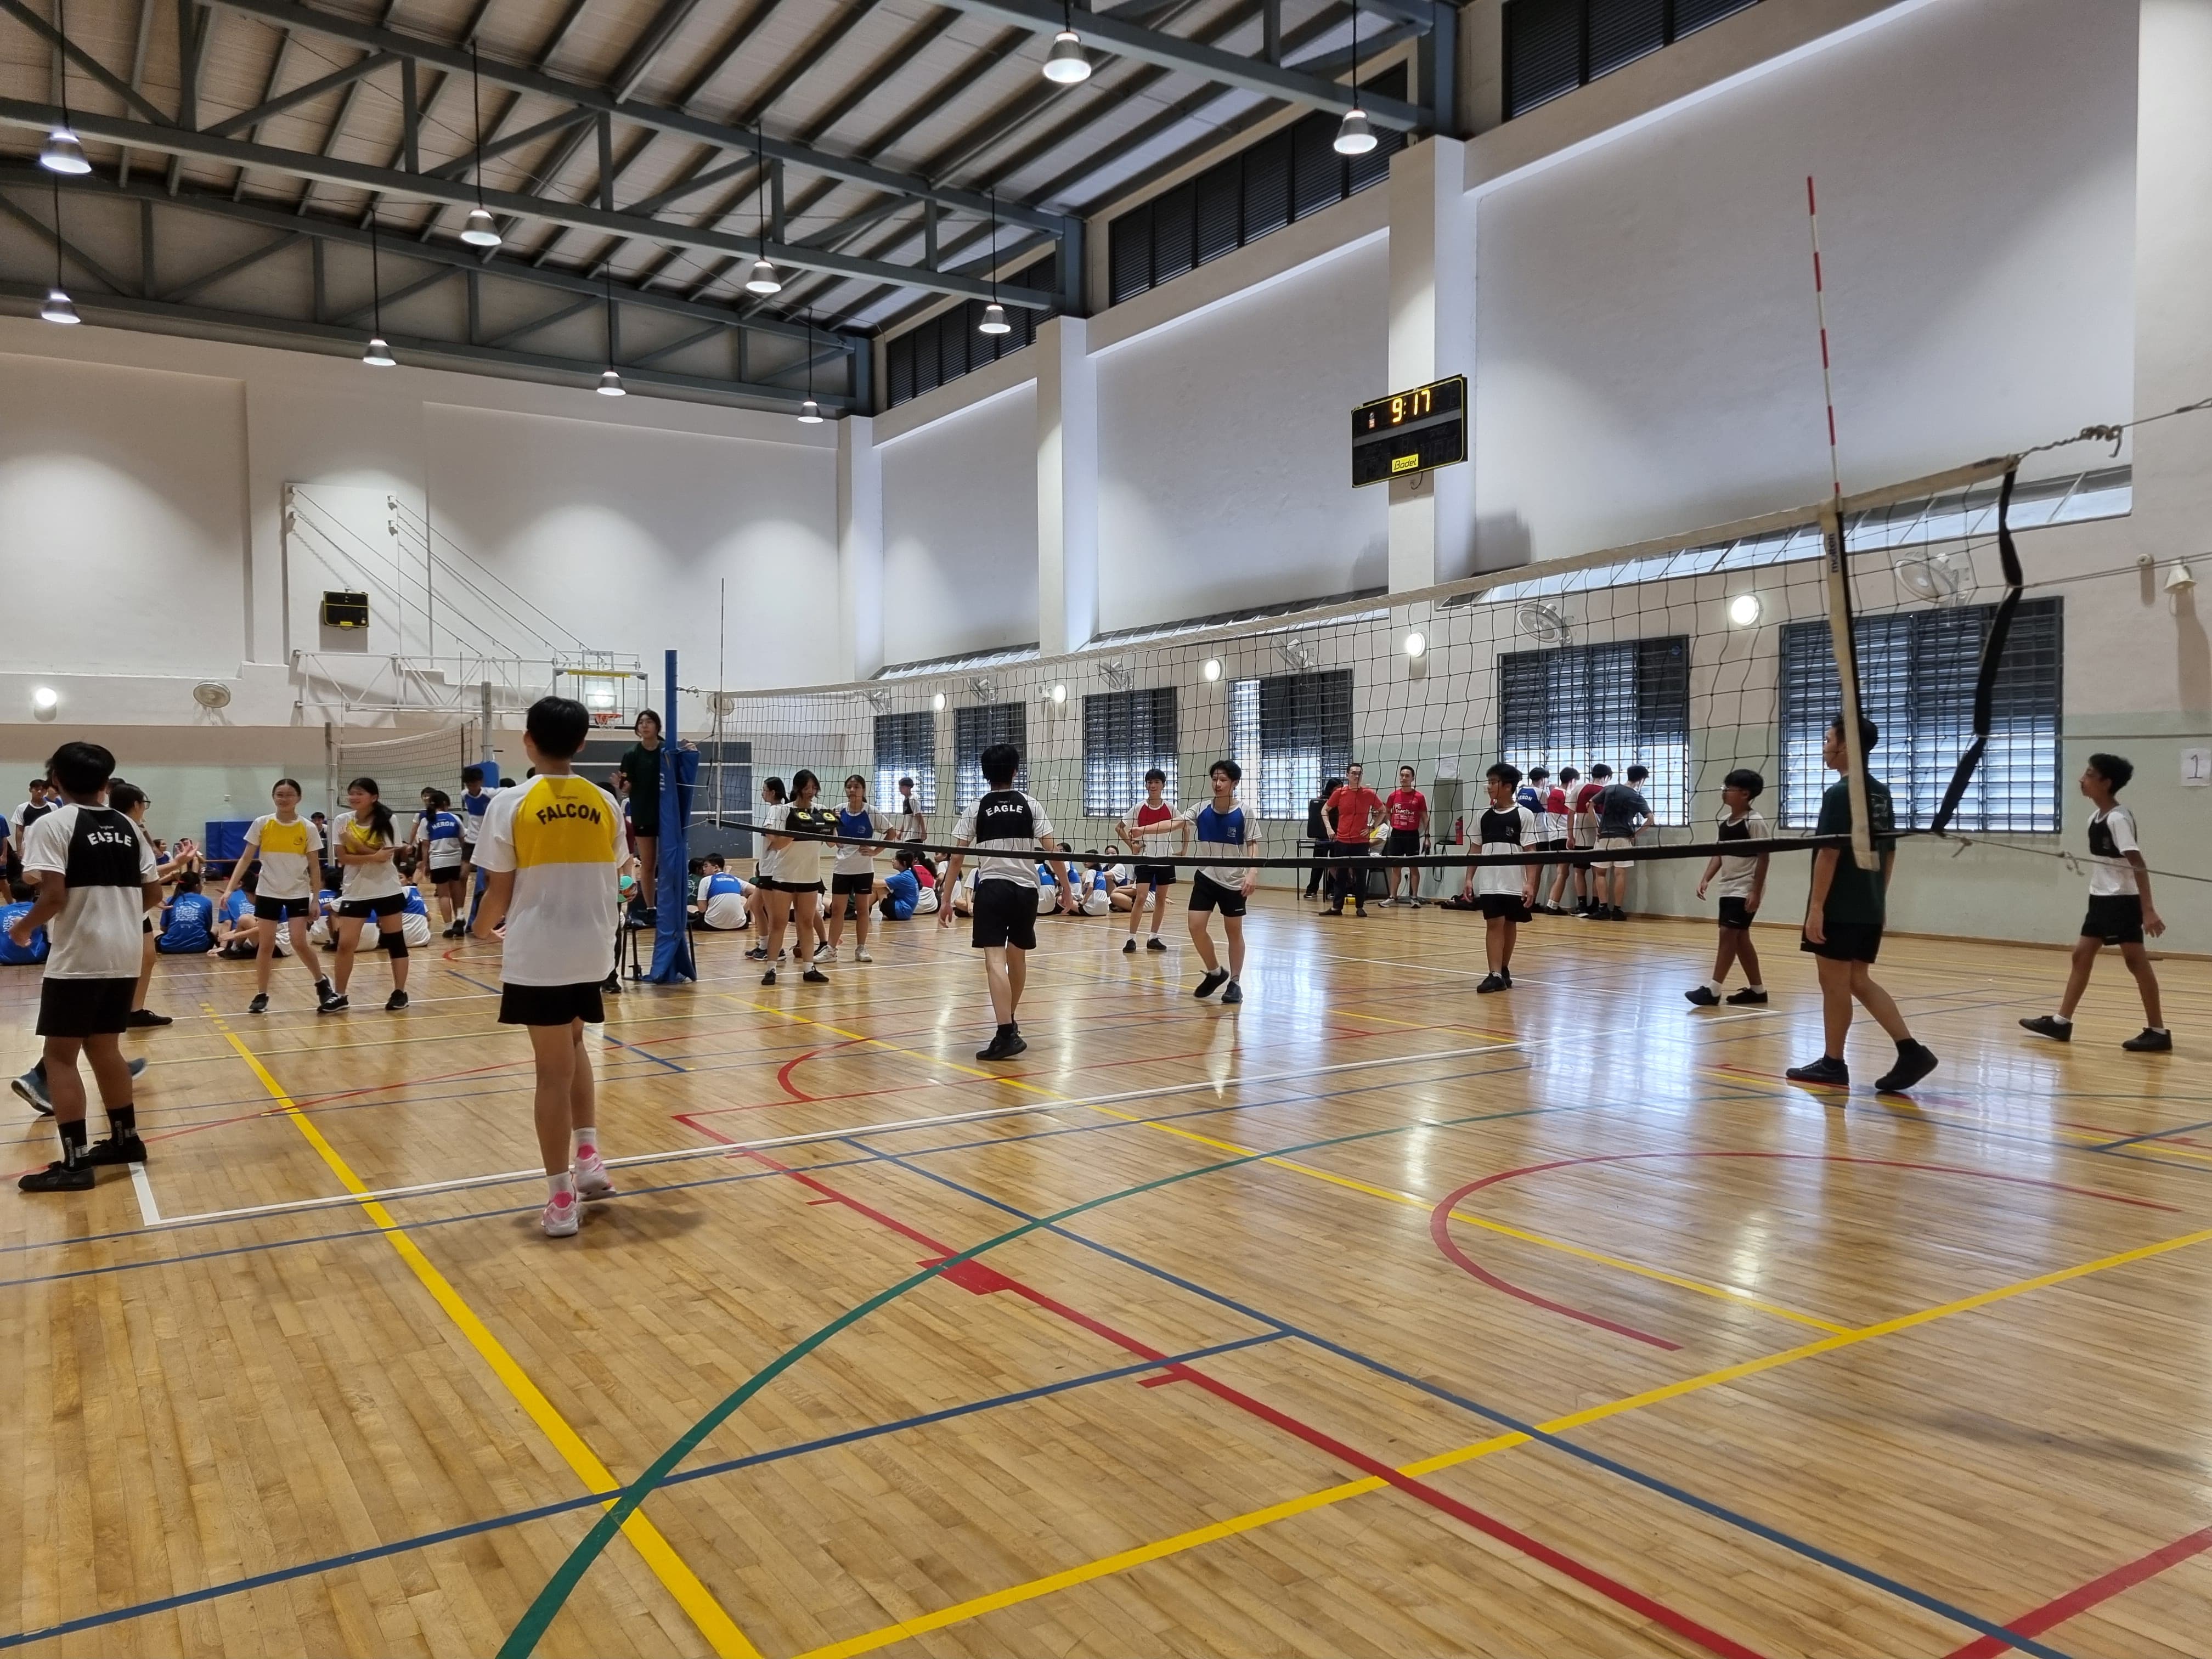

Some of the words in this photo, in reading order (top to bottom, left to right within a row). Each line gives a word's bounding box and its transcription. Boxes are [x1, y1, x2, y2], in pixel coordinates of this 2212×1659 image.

[1392, 389, 1431, 423] 9:17
[1394, 458, 1417, 470] Bodet
[1828, 533, 1838, 573] molten
[2186, 754, 2203, 779] 1
[536, 803, 601, 825] FALCON
[798, 811, 811, 820] 6
[823, 812, 836, 821] 9
[985, 804, 1023, 816] EAGLE
[87, 831, 132, 847] EAGLE
